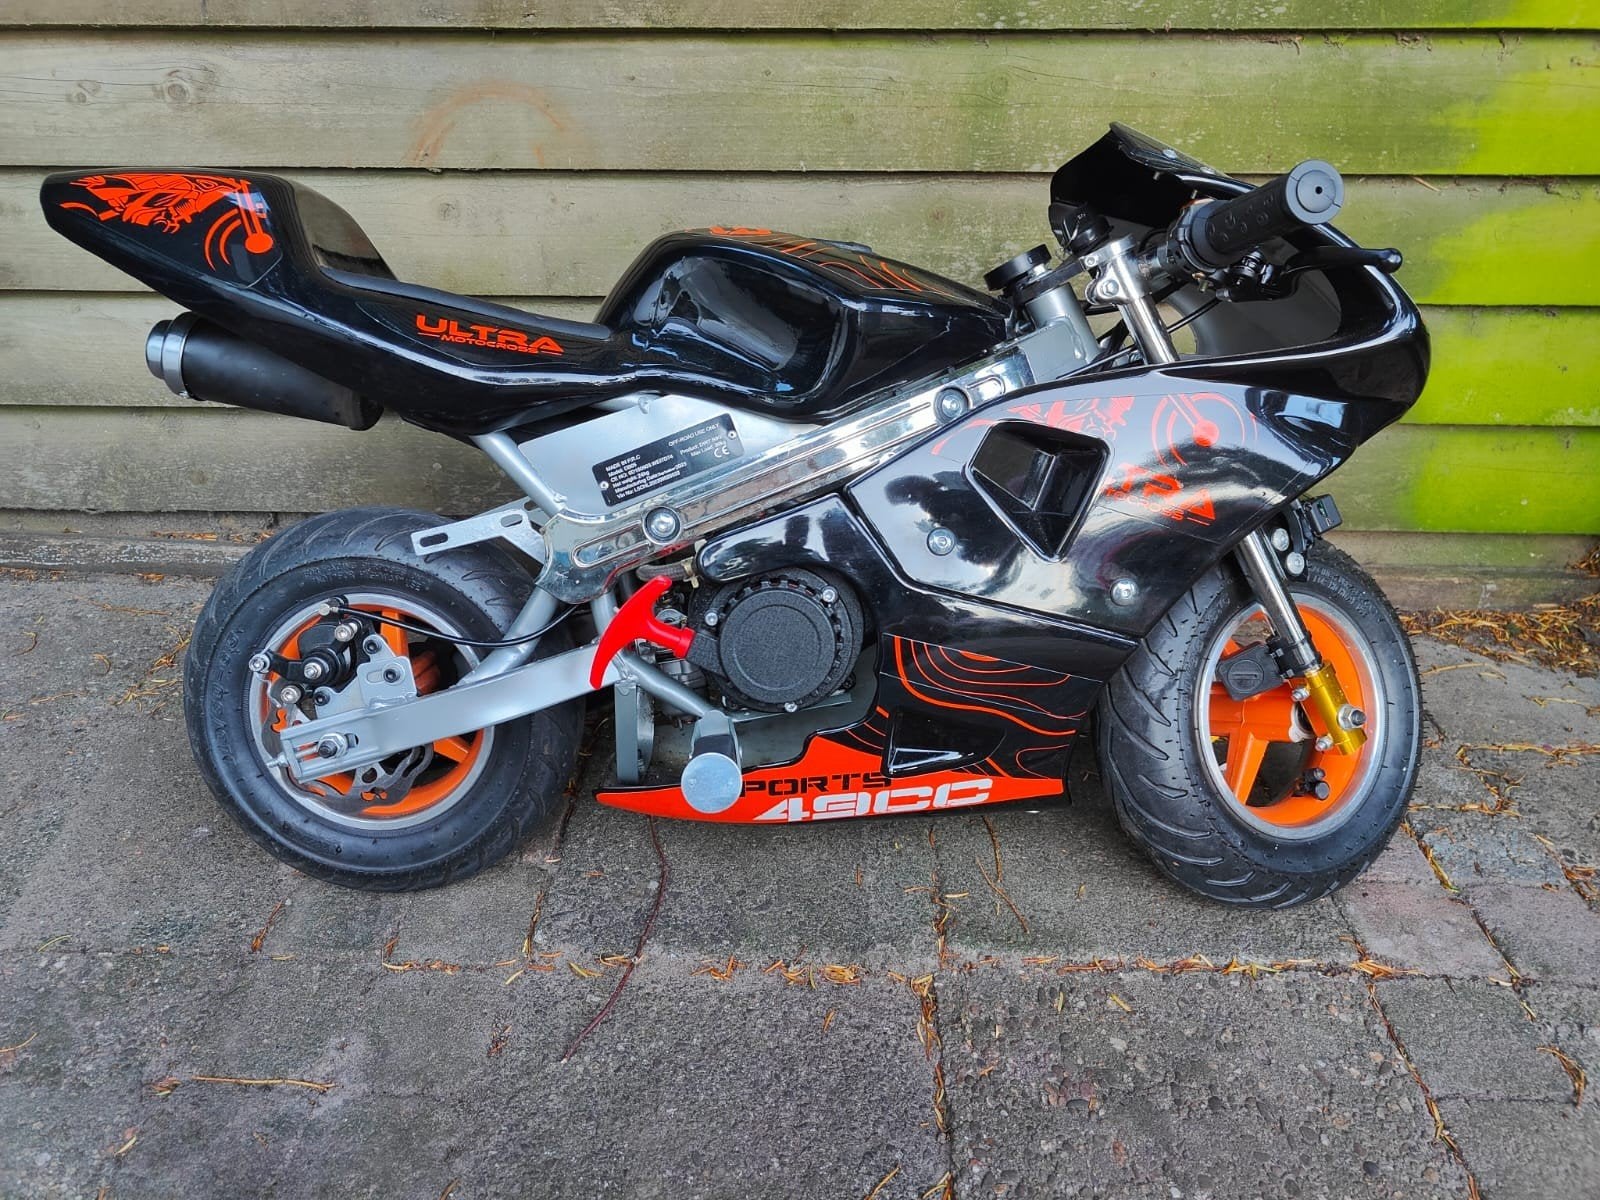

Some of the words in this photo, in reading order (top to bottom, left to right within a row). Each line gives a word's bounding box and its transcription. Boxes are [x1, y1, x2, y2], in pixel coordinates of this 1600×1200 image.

[416, 314, 564, 353] ULTRA
[441, 334, 540, 354] MOTOCROSS
[714, 445, 729, 457] CE
[740, 772, 892, 798] PORTS
